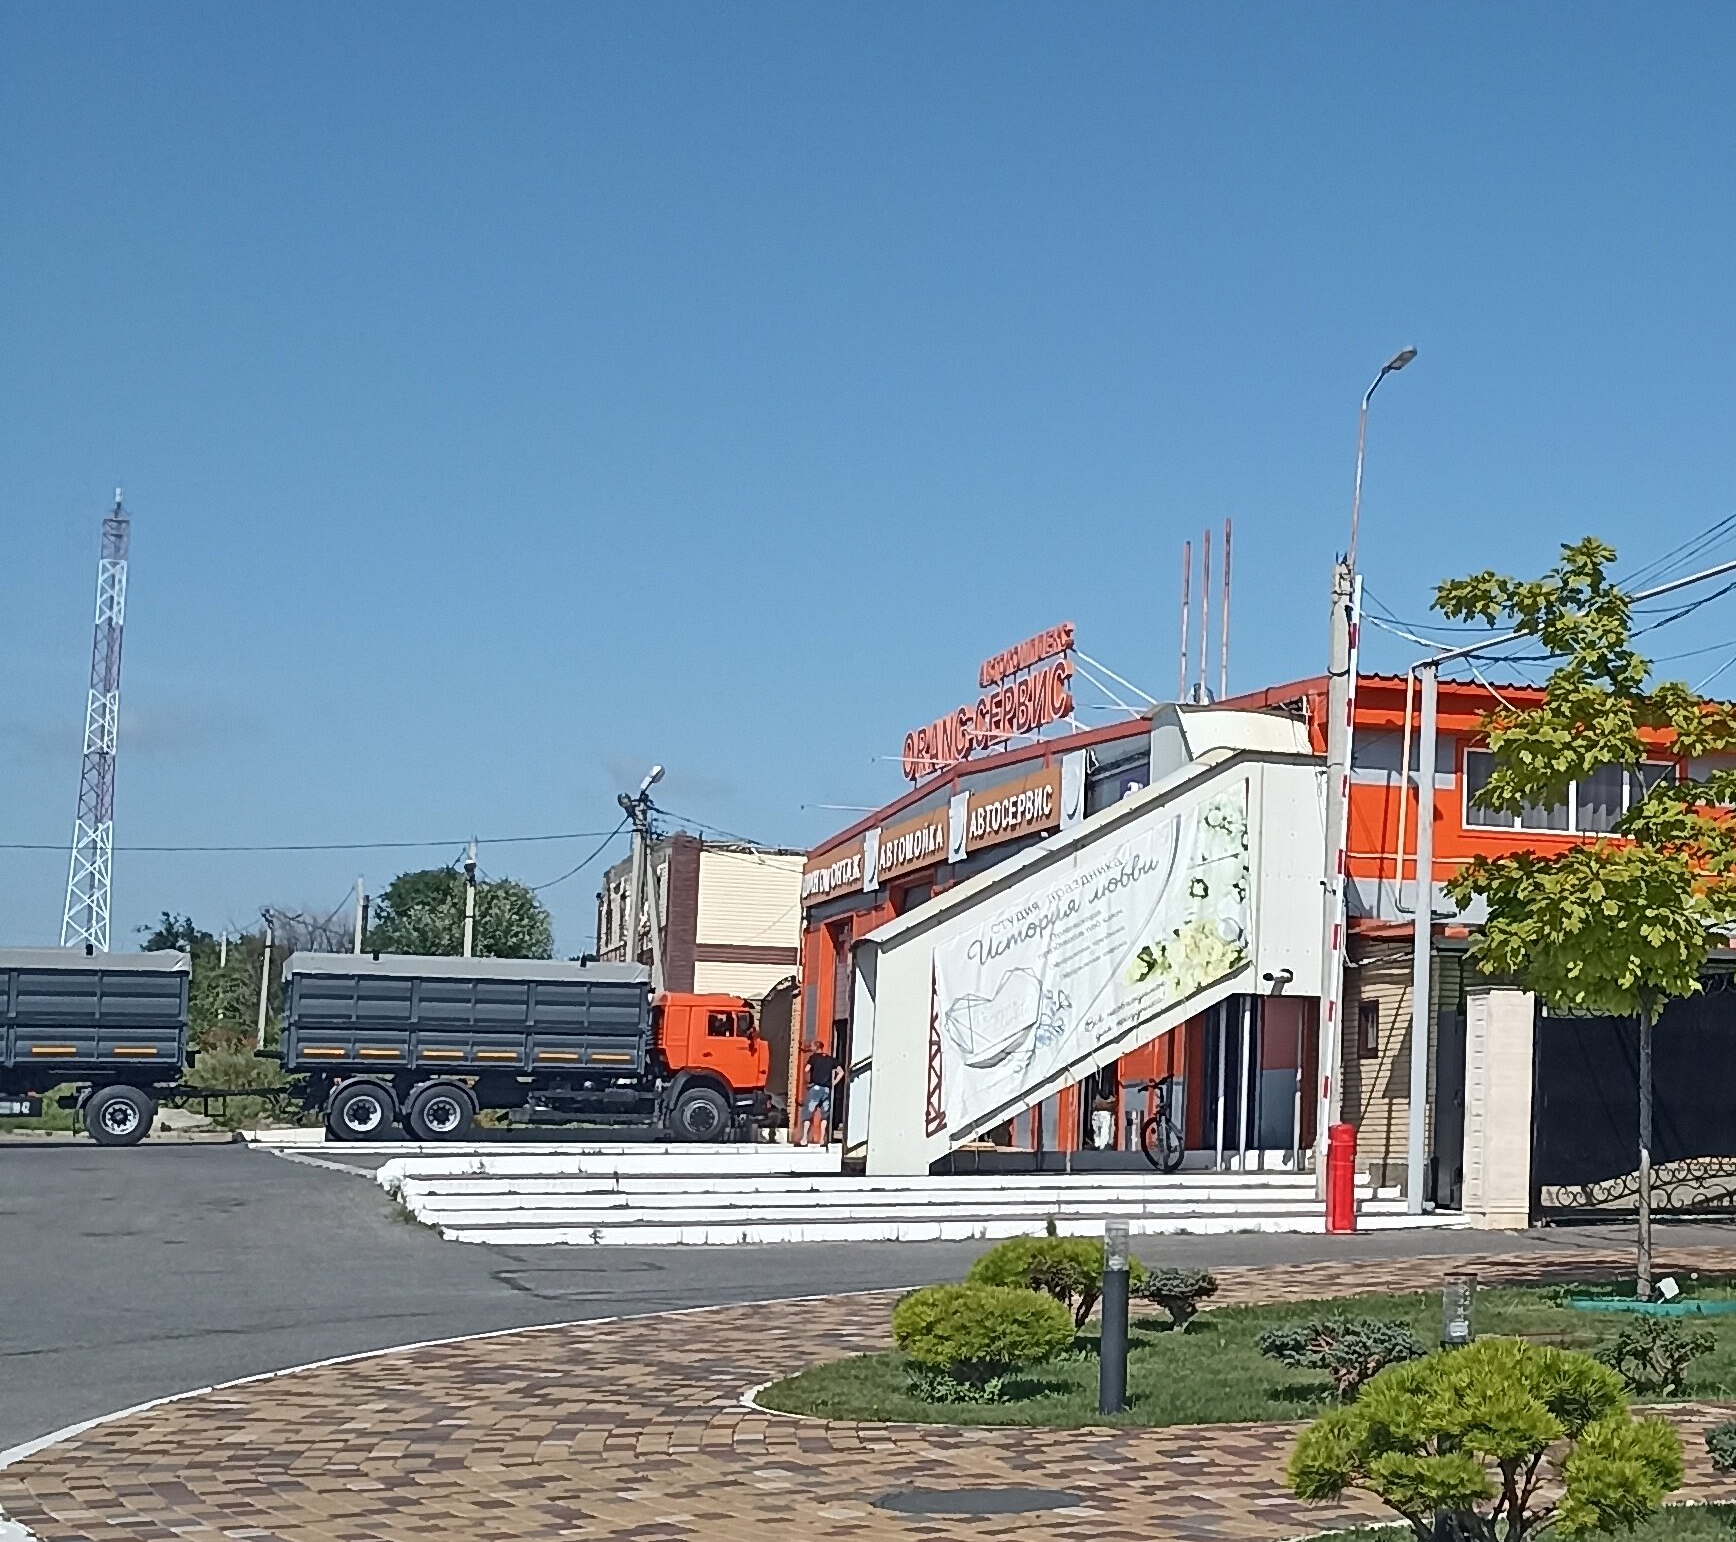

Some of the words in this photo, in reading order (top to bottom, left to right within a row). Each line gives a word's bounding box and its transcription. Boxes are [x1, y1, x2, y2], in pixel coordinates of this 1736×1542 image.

[969, 784, 1053, 839] АВТОСЕРВИС
[879, 822, 944, 871] АВТОМОЙКА
[967, 899, 1082, 966] История
[1088, 853, 1159, 905] любви
